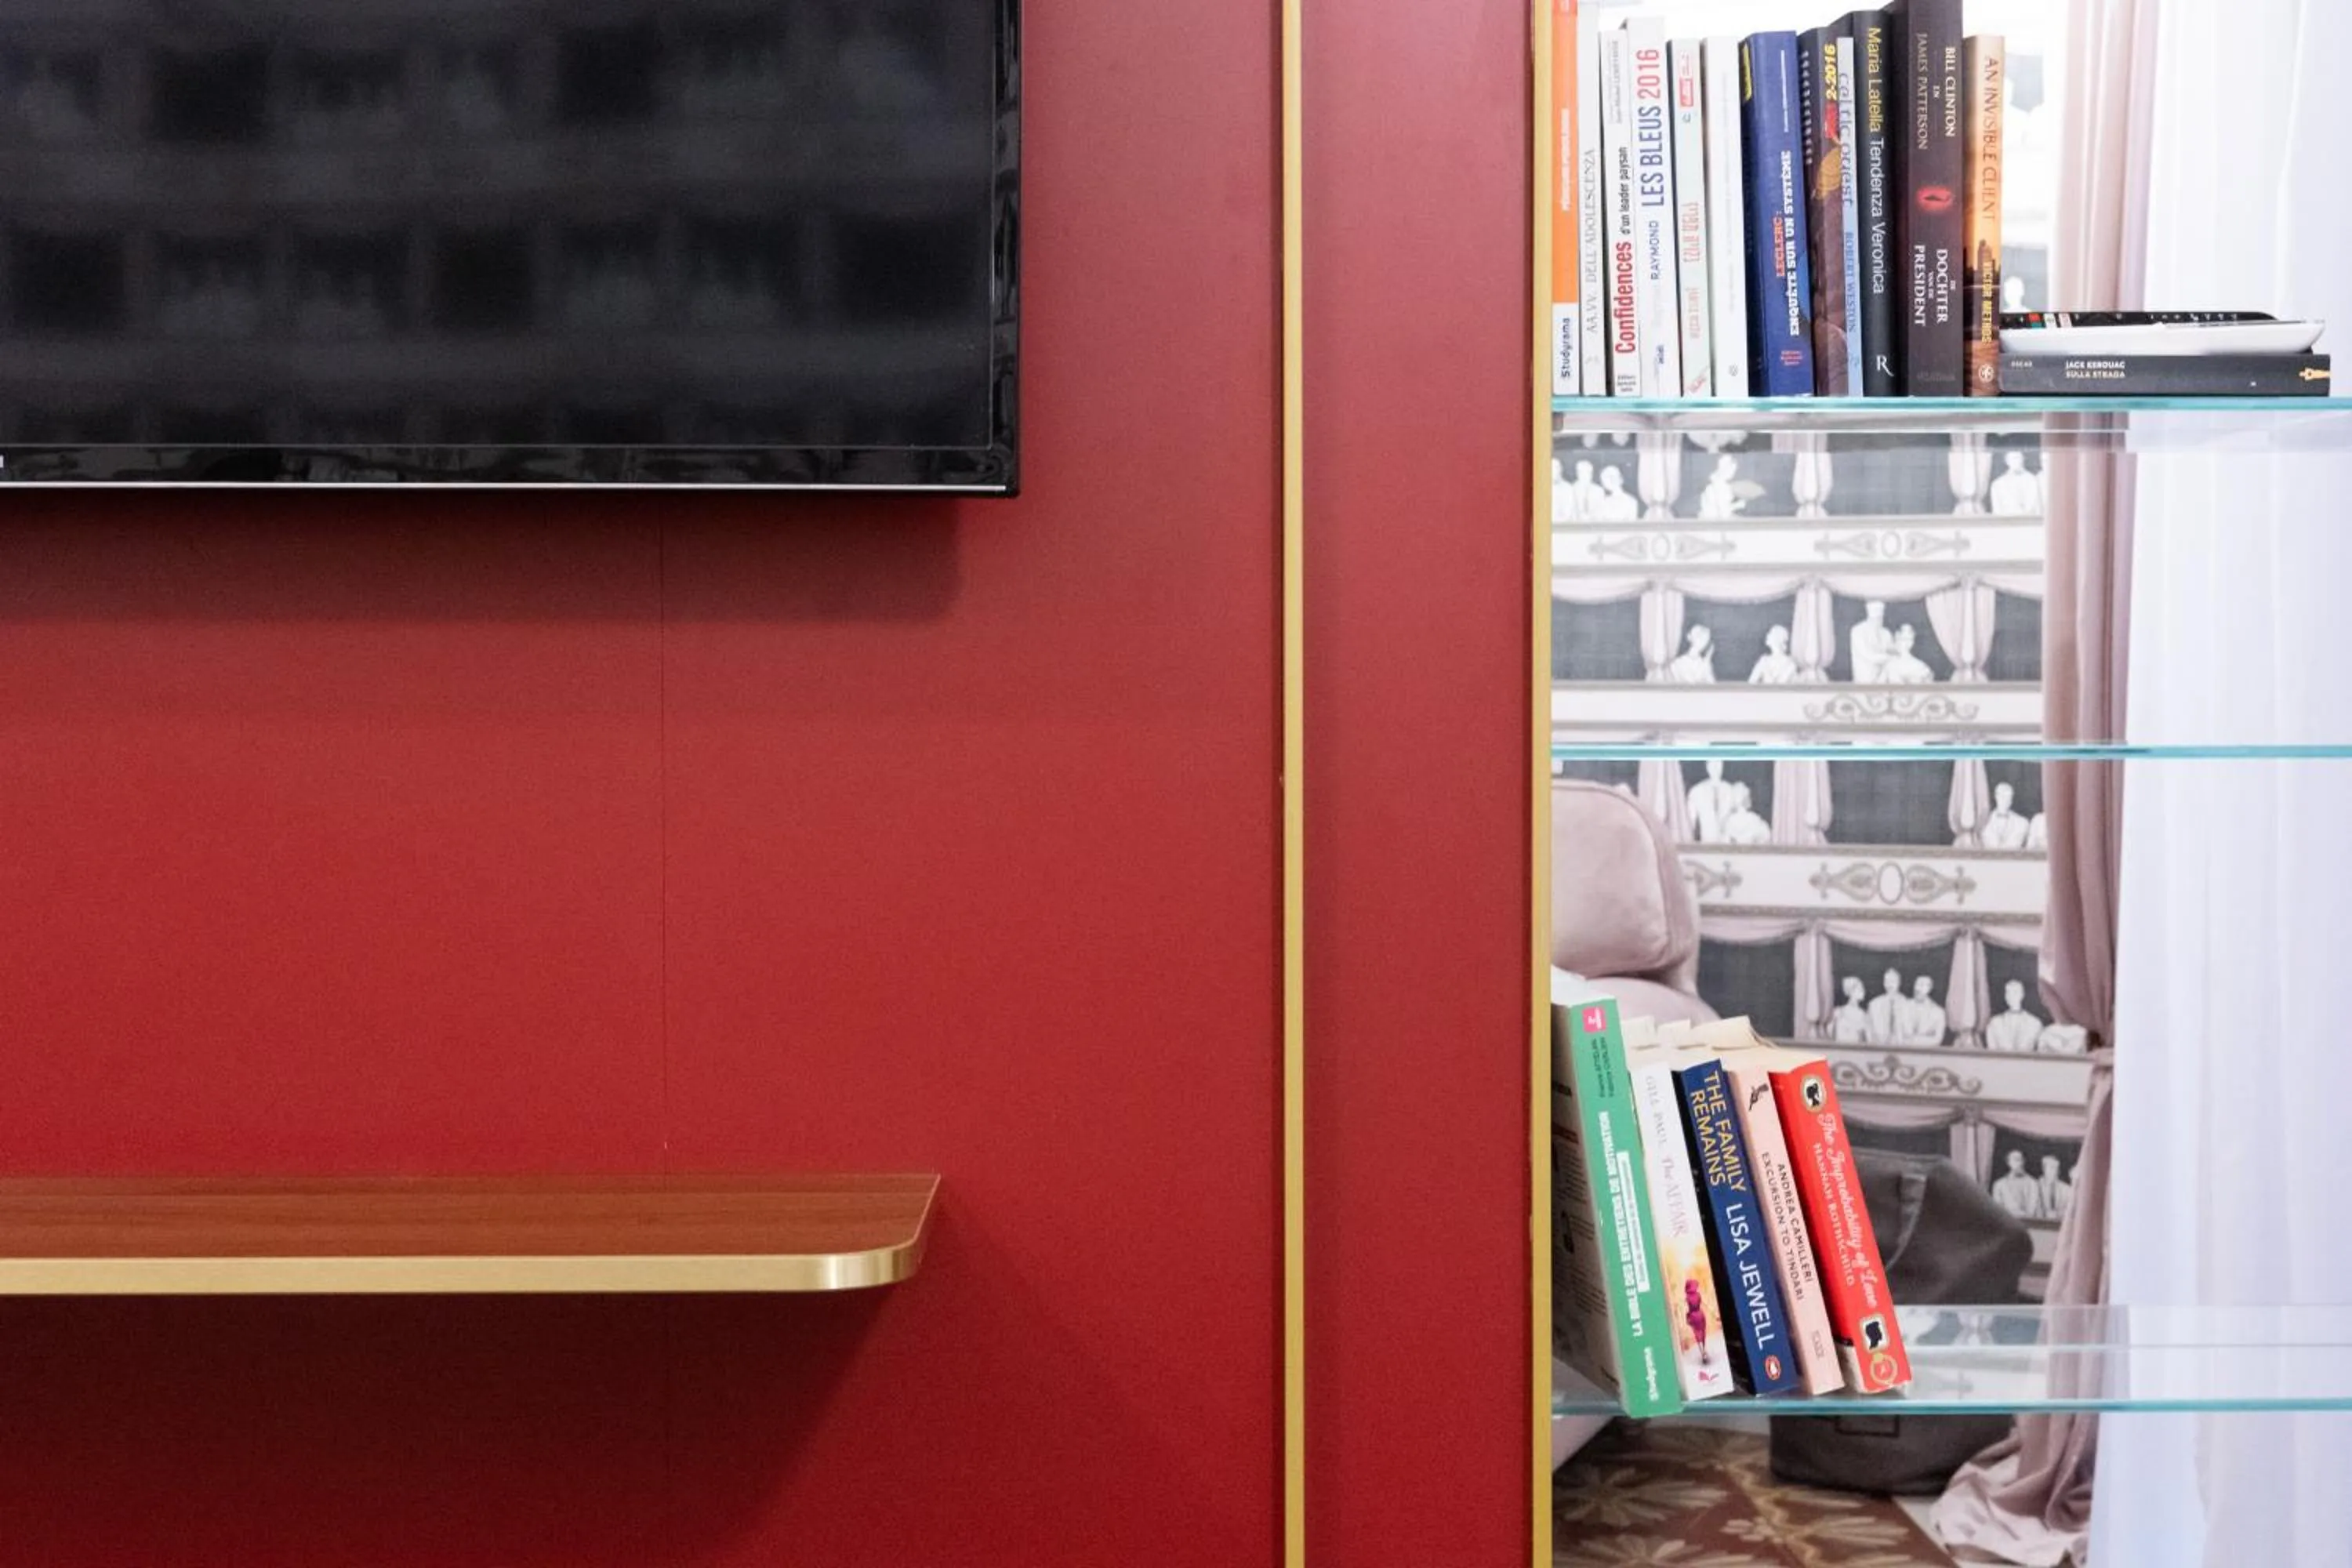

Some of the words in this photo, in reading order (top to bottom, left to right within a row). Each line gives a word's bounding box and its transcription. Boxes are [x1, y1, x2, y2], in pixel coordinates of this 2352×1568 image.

[1635, 49, 1661, 100] 2016
[1867, 27, 1882, 73] Maria
[1916, 33, 1928, 72] JAMES
[1945, 46, 1956, 72] BILL
[1984, 56, 1999, 81] AN
[1638, 105, 1663, 166] BLEUS
[1867, 79, 1883, 132] Latella
[1917, 77, 1928, 150] PATTERSON
[1945, 76, 1956, 137] CLINTON
[1983, 87, 1998, 162] INVISIBLE
[1618, 147, 1631, 180] paysan
[1640, 172, 1664, 206] LES
[1780, 151, 1794, 214] SYSTÈME
[1869, 137, 1885, 218] Tendenza
[1982, 166, 1997, 220] CLIENT
[1618, 183, 1631, 212] leader
[1621, 214, 1631, 235] d'un
[1784, 217, 1795, 238] UN
[1648, 220, 1660, 280] RAYMOND
[1786, 240, 1796, 268] SUR
[1871, 222, 1886, 294] Veronica
[1613, 241, 1636, 354] Confidences
[1785, 271, 1799, 336] ENQUÊTE
[1914, 245, 1926, 326] PRESIDENT
[1936, 249, 1948, 323] DOCHTER
[1560, 317, 1573, 379] Studyrama
[2066, 360, 2085, 369] JACK
[2086, 360, 2126, 369] KEROUAC
[1704, 1070, 1727, 1115] THE
[1690, 1089, 1726, 1188] REMAINS
[1715, 1119, 1747, 1192] FAMILY
[1817, 1112, 1838, 1145] The
[1762, 1152, 1785, 1225] EXCURSION
[1780, 1227, 1790, 1246] TO
[1786, 1247, 1805, 1301] TINDARI
[1777, 1163, 1795, 1215] ANDREA
[1790, 1218, 1813, 1283] CAMILLERI
[1813, 1142, 1834, 1201] HANNAH
[1828, 1203, 1856, 1287] ROTHSCHILD
[1825, 1147, 1864, 1250] Improbability
[1726, 1203, 1752, 1256] LISA
[1740, 1261, 1775, 1350] JEWELL
[1852, 1250, 1870, 1269] of
[1860, 1268, 1878, 1308] Love
